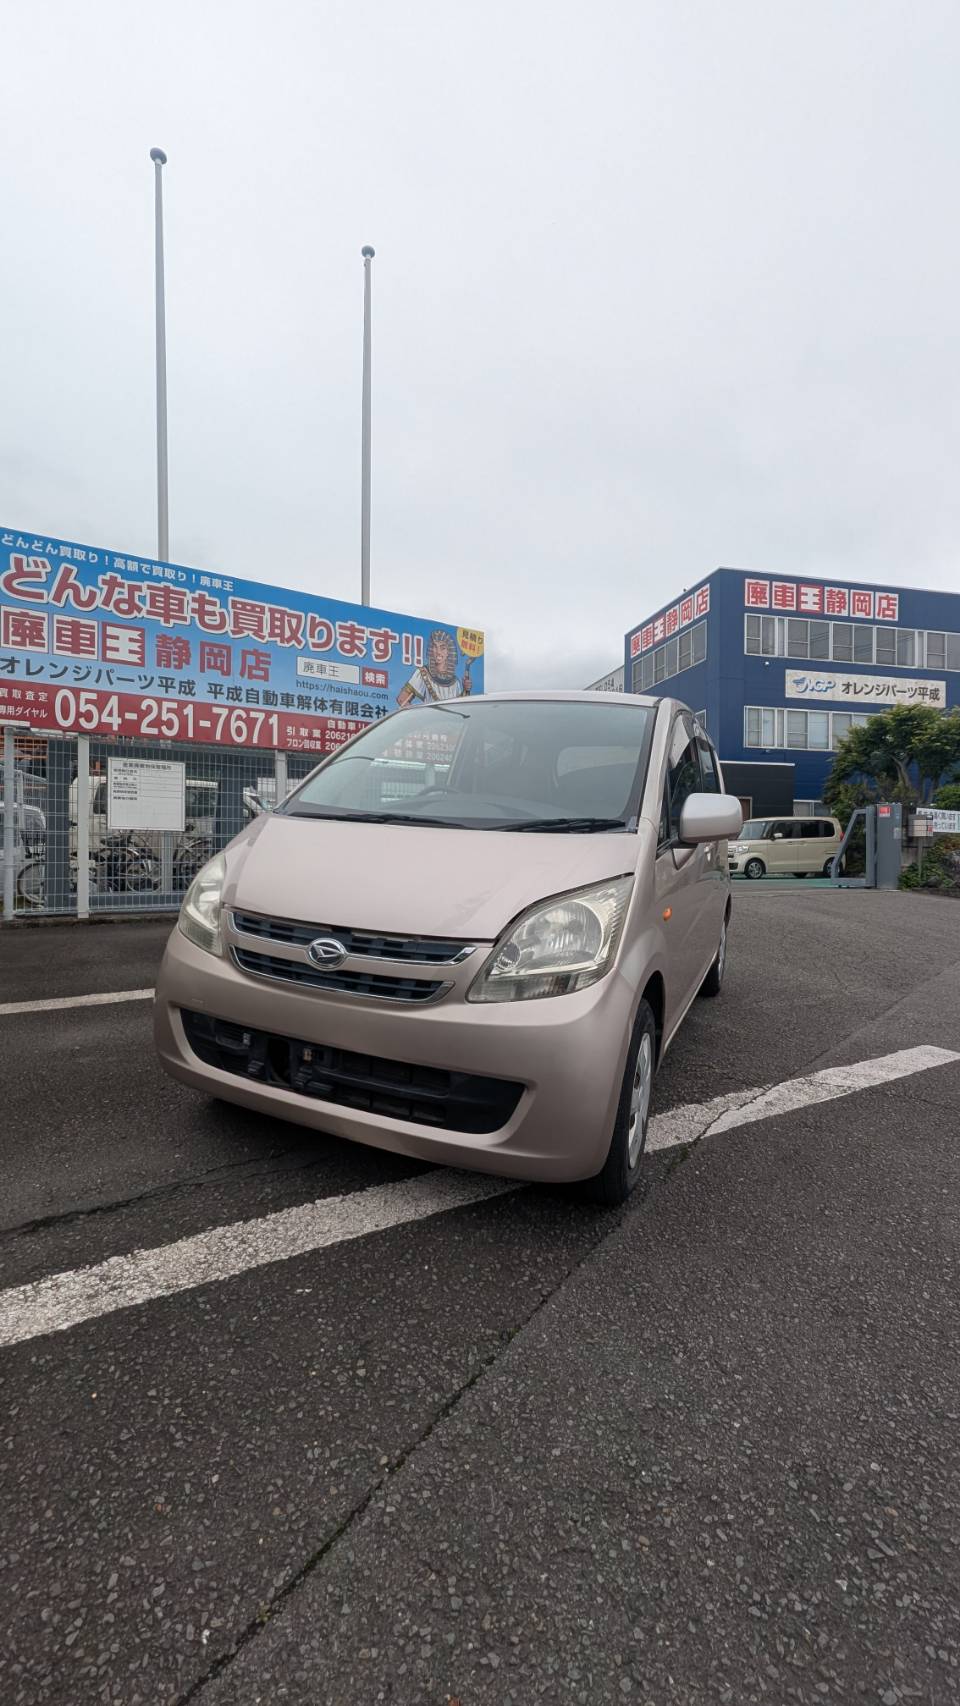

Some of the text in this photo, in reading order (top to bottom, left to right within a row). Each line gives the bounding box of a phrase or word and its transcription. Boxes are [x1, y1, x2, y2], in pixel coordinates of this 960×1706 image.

[744, 578, 899, 622] 廃車王静岡店
[630, 583, 711, 660] 廃車王静岡店
[303, 660, 341, 679] 廃車王
[364, 669, 387, 687] 検索
[0, 656, 389, 719] オレンジパーツ平成 平成自動車解体有限会社
[296, 678, 389, 702] https://haishaou.com
[841, 681, 941, 702] オレンジパーツ平成
[55, 688, 278, 747] 054-251-7671
